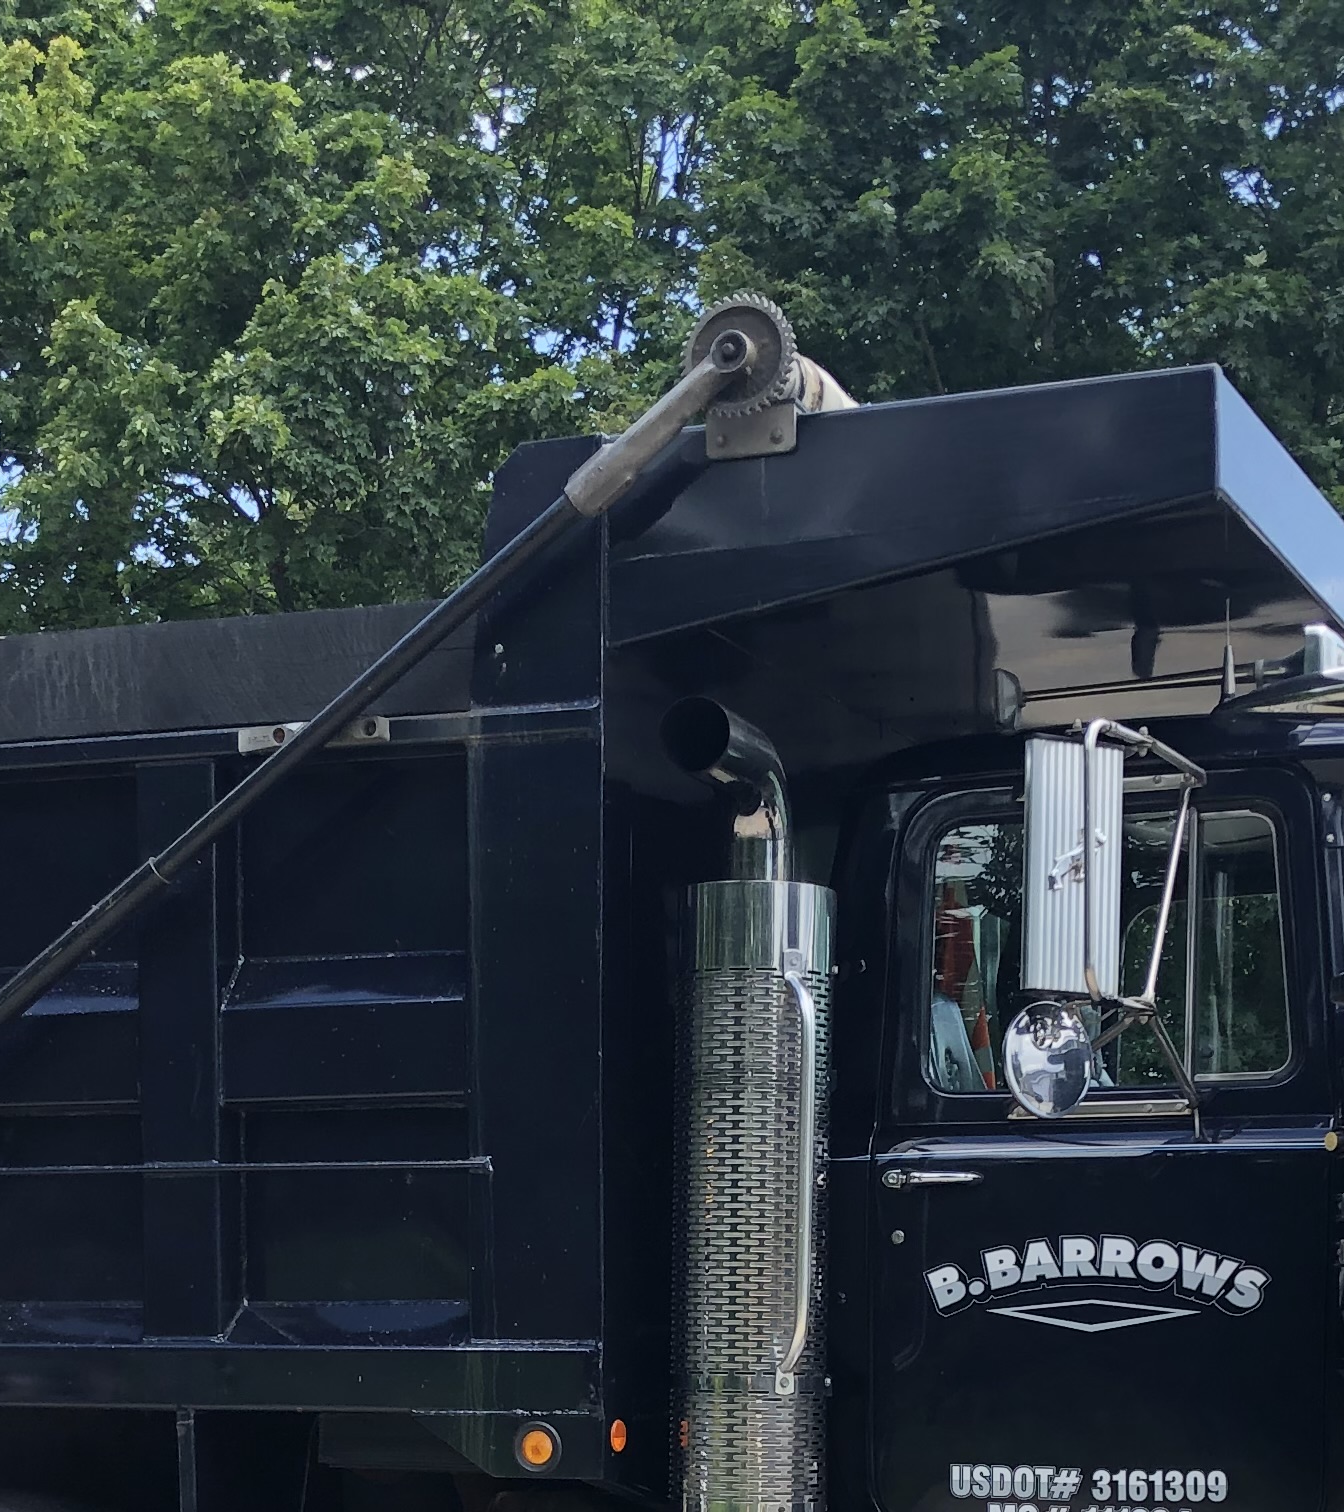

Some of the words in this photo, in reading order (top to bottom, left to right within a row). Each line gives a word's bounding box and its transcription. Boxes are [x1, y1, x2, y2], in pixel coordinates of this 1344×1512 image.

[924, 1234, 1272, 1317] B.BARROWS
[950, 1464, 1082, 1499] USDOT#
[1090, 1468, 1228, 1502] 3161309
